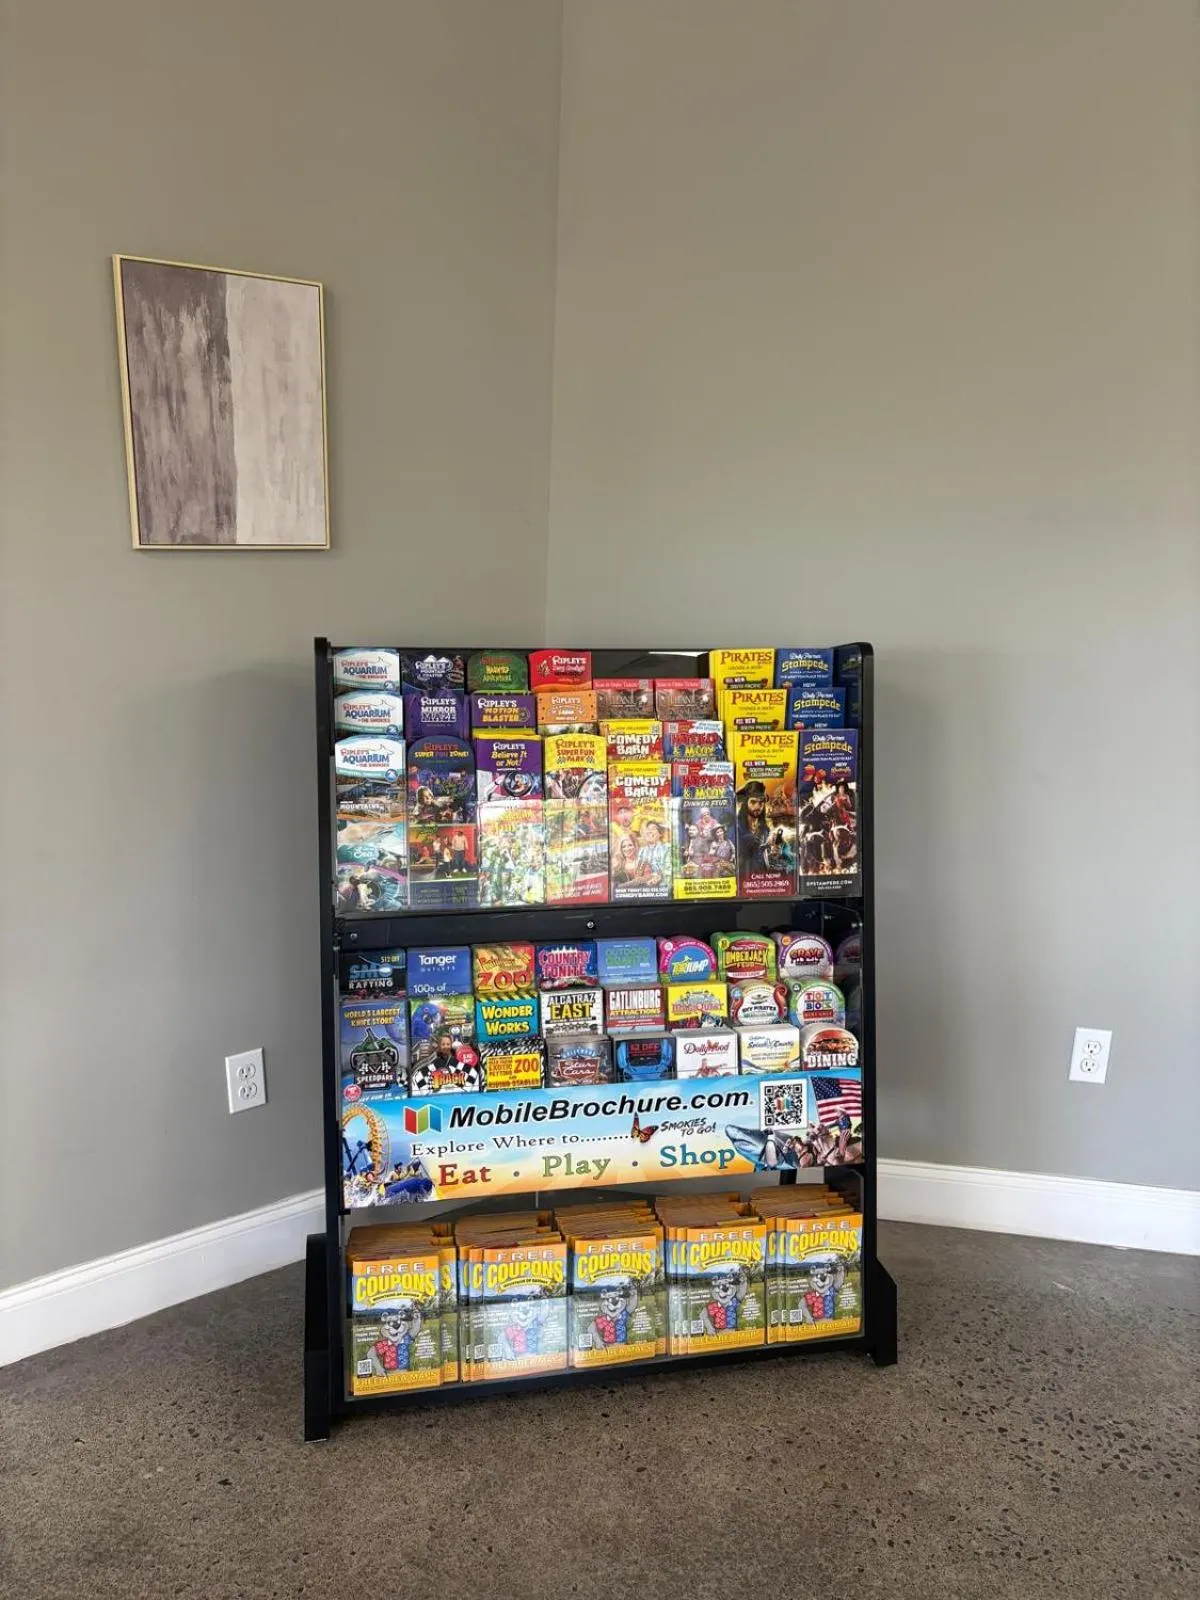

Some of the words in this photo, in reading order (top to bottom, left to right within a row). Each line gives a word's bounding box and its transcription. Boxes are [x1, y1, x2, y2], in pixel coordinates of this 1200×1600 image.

[552, 655, 587, 665] RIPLEY'S
[721, 652, 772, 665] PIRATES
[343, 665, 388, 676] AQUARIUM
[782, 659, 829, 673] Stampede
[421, 696, 457, 706] RIPLEY'S
[477, 697, 518, 709] RIPLEY'S
[732, 691, 784, 705] PIRATES
[793, 699, 841, 712] Stampede
[345, 709, 391, 719] AQUARIUM
[482, 714, 519, 722] BLASTER
[493, 741, 526, 751] RIPLEY'S
[556, 739, 595, 749] RIPLEY'S
[608, 734, 659, 745] COMEDY
[741, 734, 795, 748] PIRATES
[491, 750, 519, 759] Believe
[520, 750, 528, 758] It
[557, 748, 580, 756] SUPER
[581, 748, 595, 756] FUN
[617, 744, 650, 755] BARN
[804, 741, 853, 755] Stampede
[343, 753, 390, 764] AQUARIUM
[505, 758, 523, 767] Not!
[567, 754, 585, 762] PARK
[615, 776, 667, 787] COMEDY
[624, 786, 658, 797] BARN
[684, 800, 710, 808] DINNER
[538, 949, 592, 965] COUNTRY
[789, 948, 825, 960] CRAVE
[418, 955, 457, 967] Tanger
[542, 963, 586, 979] TONITE
[349, 979, 394, 990] RAFTING
[477, 970, 532, 991] ZOO
[413, 983, 435, 993] 100s
[436, 982, 447, 992] of
[547, 992, 597, 1007] ALCATRAZ
[609, 989, 661, 1010] GATLINBURG
[482, 1005, 533, 1020] WONDER
[550, 1003, 593, 1020] EAST
[610, 1007, 661, 1017] ATTRACTIONS
[486, 1021, 530, 1036] WORKS
[683, 1040, 731, 1055] Dollywood
[513, 1058, 540, 1073] ZOO
[565, 1061, 596, 1069] Star
[807, 1053, 857, 1068] DINING
[563, 1067, 595, 1076] Cars
[431, 1070, 465, 1089] TRACK
[449, 1091, 749, 1129] MobileBrochure.com
[660, 1117, 707, 1132] SMOKIES
[680, 1127, 695, 1137] TO
[696, 1121, 717, 1135] GO!
[412, 1141, 485, 1157] Explore
[492, 1134, 556, 1149] Where
[438, 1163, 492, 1186] Eat
[542, 1152, 611, 1181] Play
[660, 1143, 736, 1170] Shop
[799, 1221, 850, 1232] FREE
[700, 1230, 753, 1242] FREE
[588, 1242, 642, 1254] FREE
[789, 1230, 858, 1257] COUPONS
[497, 1249, 554, 1262] FREE
[690, 1240, 762, 1267] COUPONS
[366, 1262, 425, 1275] FREE
[577, 1252, 652, 1280] COUPONS
[487, 1260, 564, 1289] COUPONS
[356, 1272, 437, 1303] COUPONS
